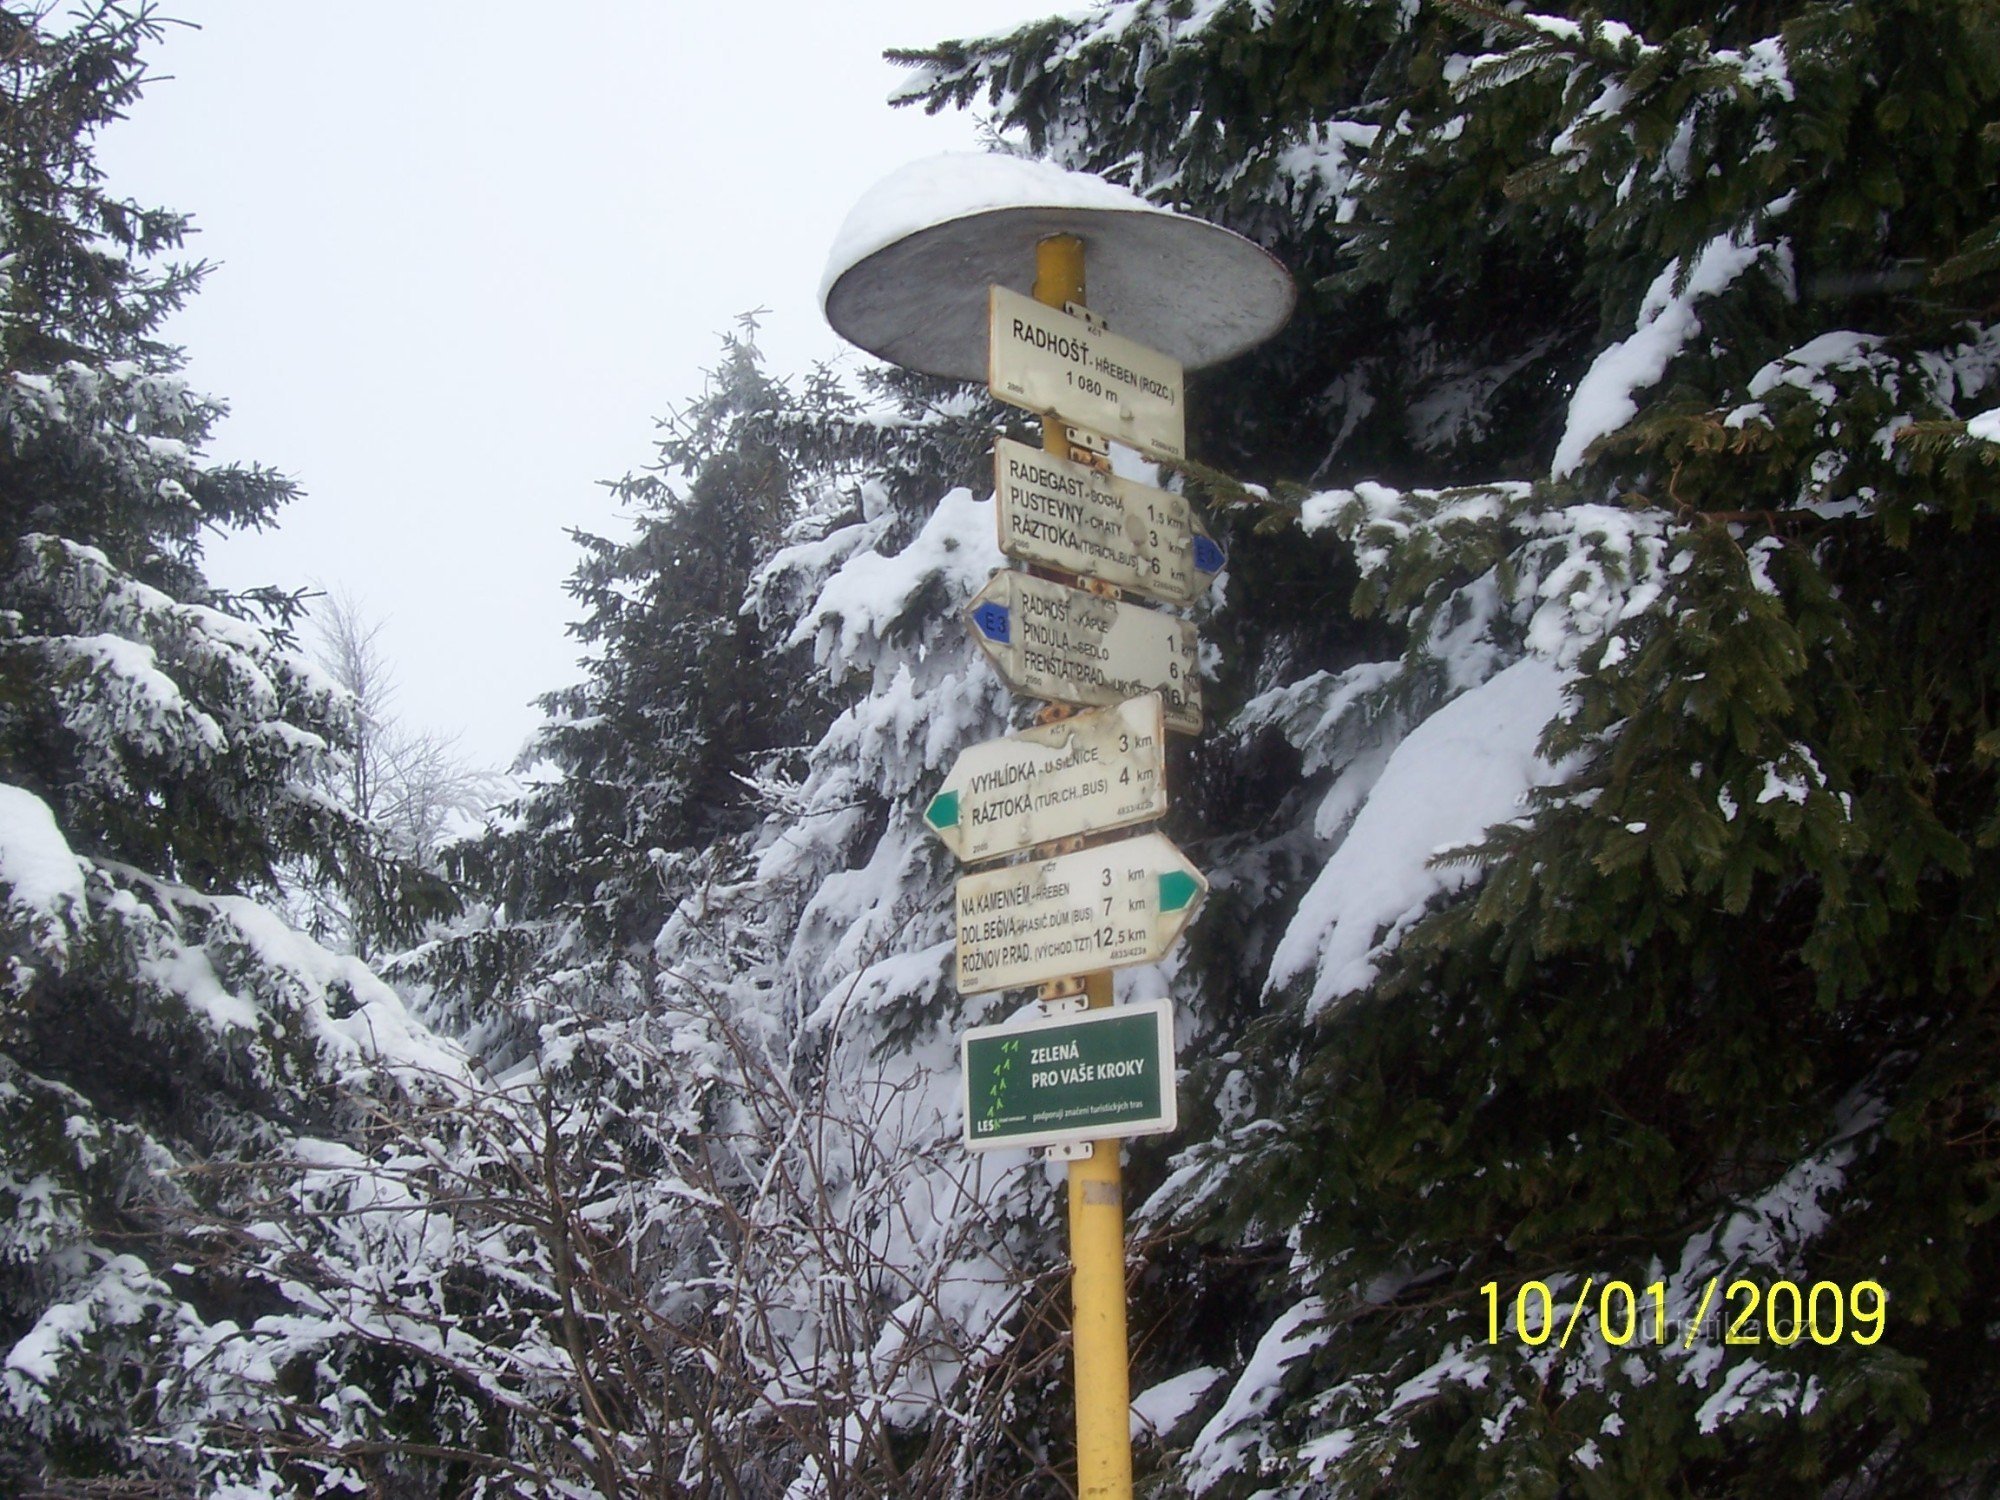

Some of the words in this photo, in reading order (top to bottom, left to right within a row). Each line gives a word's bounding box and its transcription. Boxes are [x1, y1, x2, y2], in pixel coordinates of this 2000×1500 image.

[1013, 318, 1089, 367] RADHOŠŤ
[1106, 389, 1118, 404] m
[1009, 459, 1084, 499] RADEGAST
[1166, 513, 1184, 530] km
[1010, 486, 1085, 525] PUSTEVNY
[1149, 530, 1159, 547] 3
[1168, 540, 1184, 555] km
[1012, 511, 1079, 551] RÁZTOKA
[1151, 558, 1161, 575] 6
[1170, 566, 1185, 581] km
[1166, 634, 1175, 652] 1
[1169, 662, 1179, 680] 6
[971, 759, 1036, 795] VYHLÍDKA
[1118, 734, 1129, 753] 3
[1134, 733, 1153, 750] km
[971, 793, 1033, 827] RÁZTOKA
[1118, 766, 1130, 786] 4
[1136, 767, 1154, 782] km
[961, 895, 976, 917] NA
[977, 882, 1031, 914] KAMENNÉM
[1101, 868, 1112, 887] 3
[1128, 868, 1145, 882] km
[1103, 897, 1113, 916] 7
[1128, 898, 1146, 912] km
[962, 943, 1000, 974] ROŽNOV
[1128, 928, 1146, 942] km
[1030, 1039, 1080, 1065] ZELENÁ
[1032, 1070, 1059, 1089] PRO
[1060, 1063, 1094, 1085] VAŠE
[1097, 1058, 1145, 1081] KROKY
